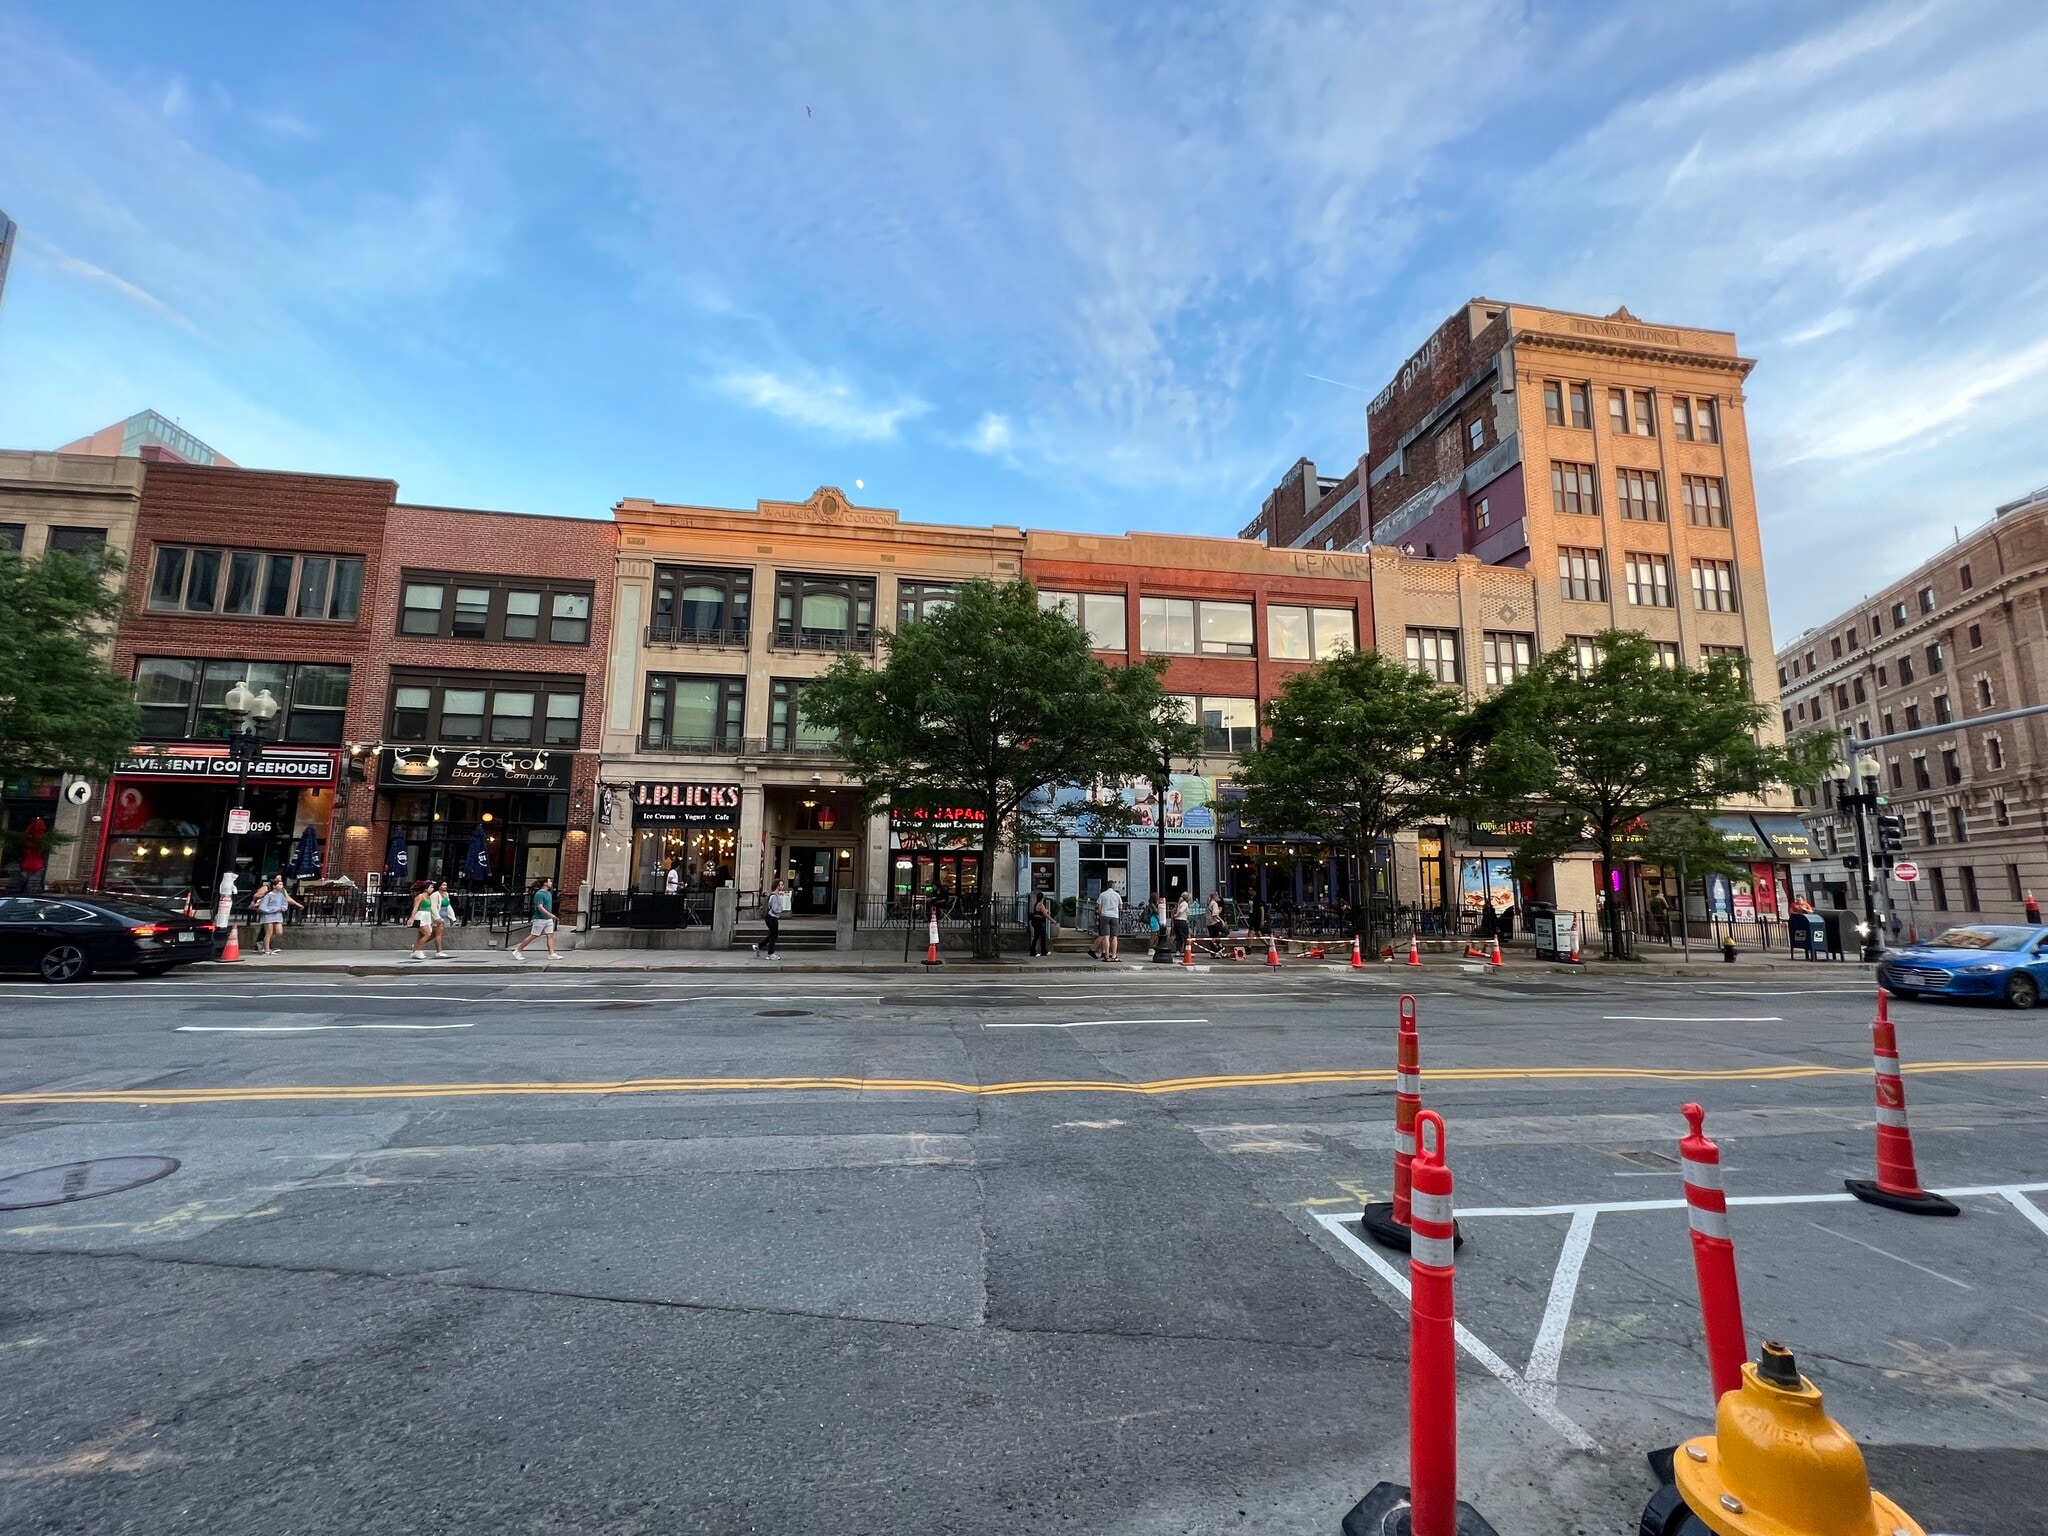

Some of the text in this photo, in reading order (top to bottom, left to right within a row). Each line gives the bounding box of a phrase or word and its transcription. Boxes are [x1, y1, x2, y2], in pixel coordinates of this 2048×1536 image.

[1576, 322, 1620, 337] FENWAY
[764, 508, 891, 526] WALKER GORDON
[1293, 553, 1369, 579] LEMUR
[451, 769, 559, 788] Burger Company
[643, 812, 730, 822] Ice Cream Yogurt Cafe
[1771, 834, 1809, 845] Symphony
[1787, 847, 1809, 855] Mart
